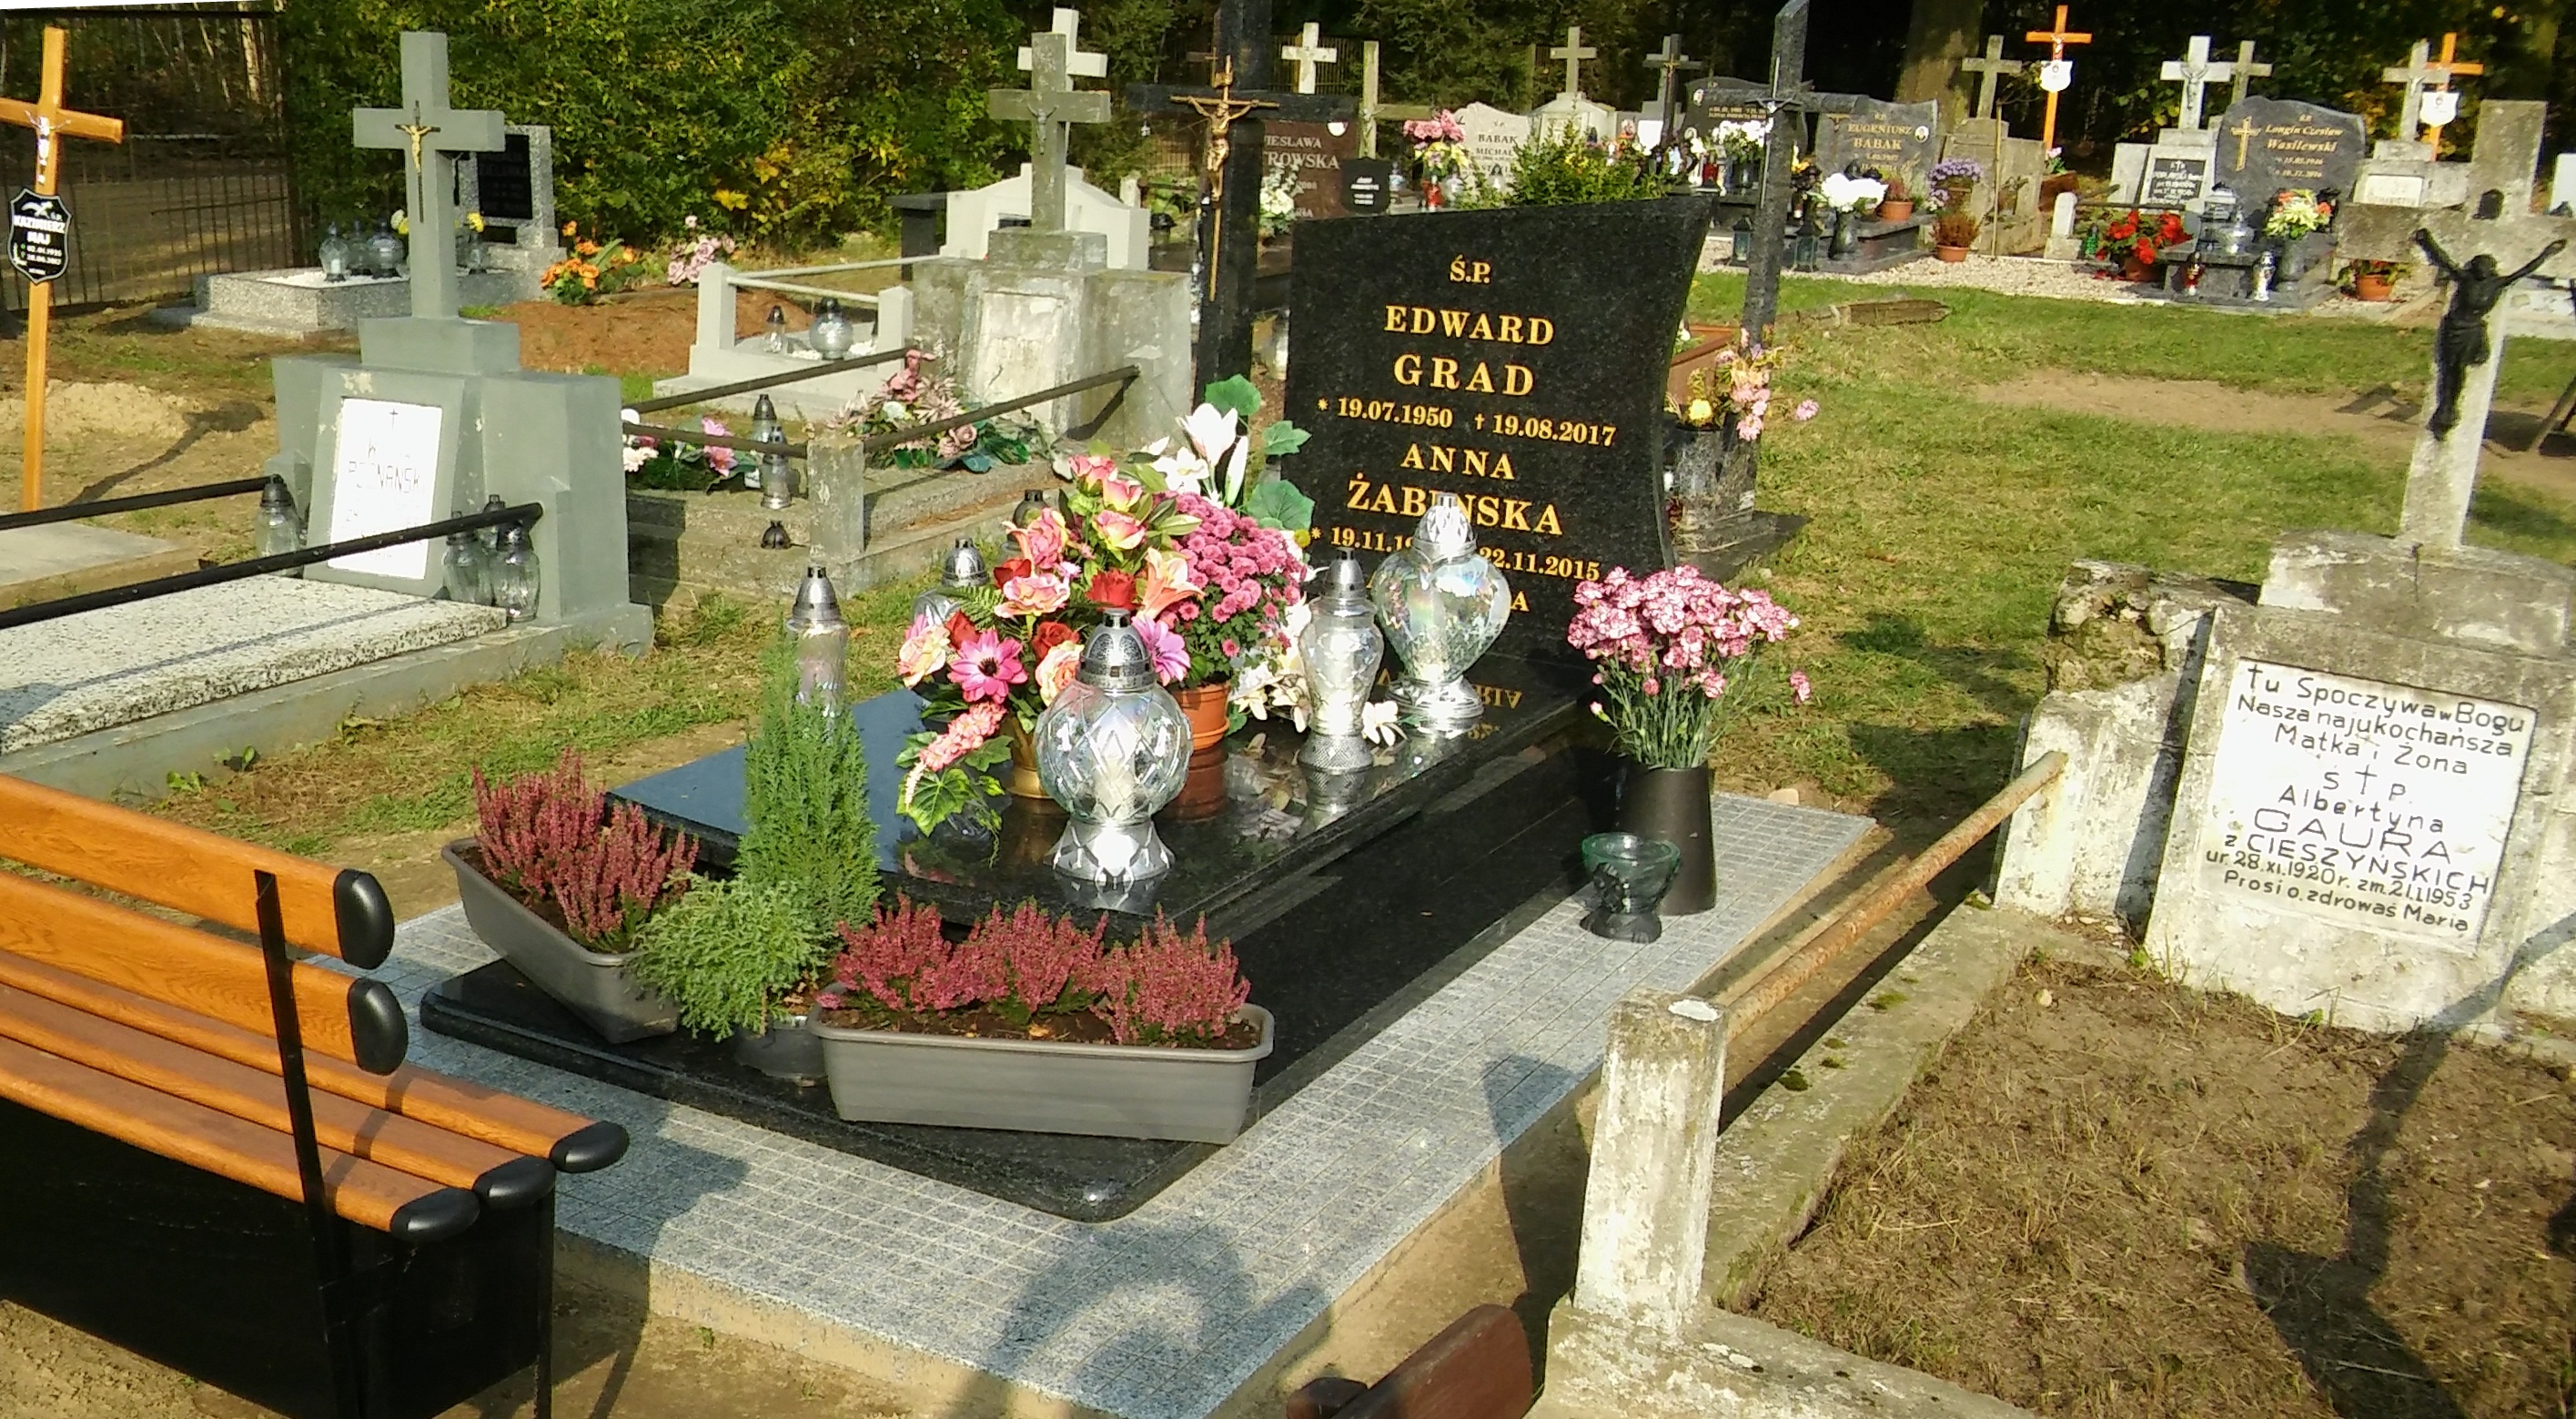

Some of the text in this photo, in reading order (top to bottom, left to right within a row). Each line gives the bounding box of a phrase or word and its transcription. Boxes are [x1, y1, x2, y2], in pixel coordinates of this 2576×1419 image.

[1478, 134, 1518, 144] BABAK
[1848, 124, 1912, 135] EUGENIUSZ
[1854, 137, 1903, 150] BABAK
[2267, 138, 2338, 153] Wasilewski
[1263, 151, 1340, 170] ROWSKA
[1450, 254, 1491, 284] Ś.P.
[1384, 305, 1554, 345] EDWARD
[1393, 353, 1534, 396] GRAD
[1338, 397, 1616, 447] 19.07.1950 19.08.2017
[1400, 442, 1515, 481] ANNA
[2238, 694, 2310, 723] Nasza
[2455, 702, 2525, 736] Bogu
[2275, 723, 2360, 756] Matka
[2394, 742, 2468, 775] Żona
[2278, 785, 2443, 833] Albertyna
[2254, 808, 2450, 864] GAURA
[2225, 834, 2490, 894] z CIESZYŃSKICH
[2224, 869, 2284, 895] Prosi
[2403, 903, 2469, 932] Maria
